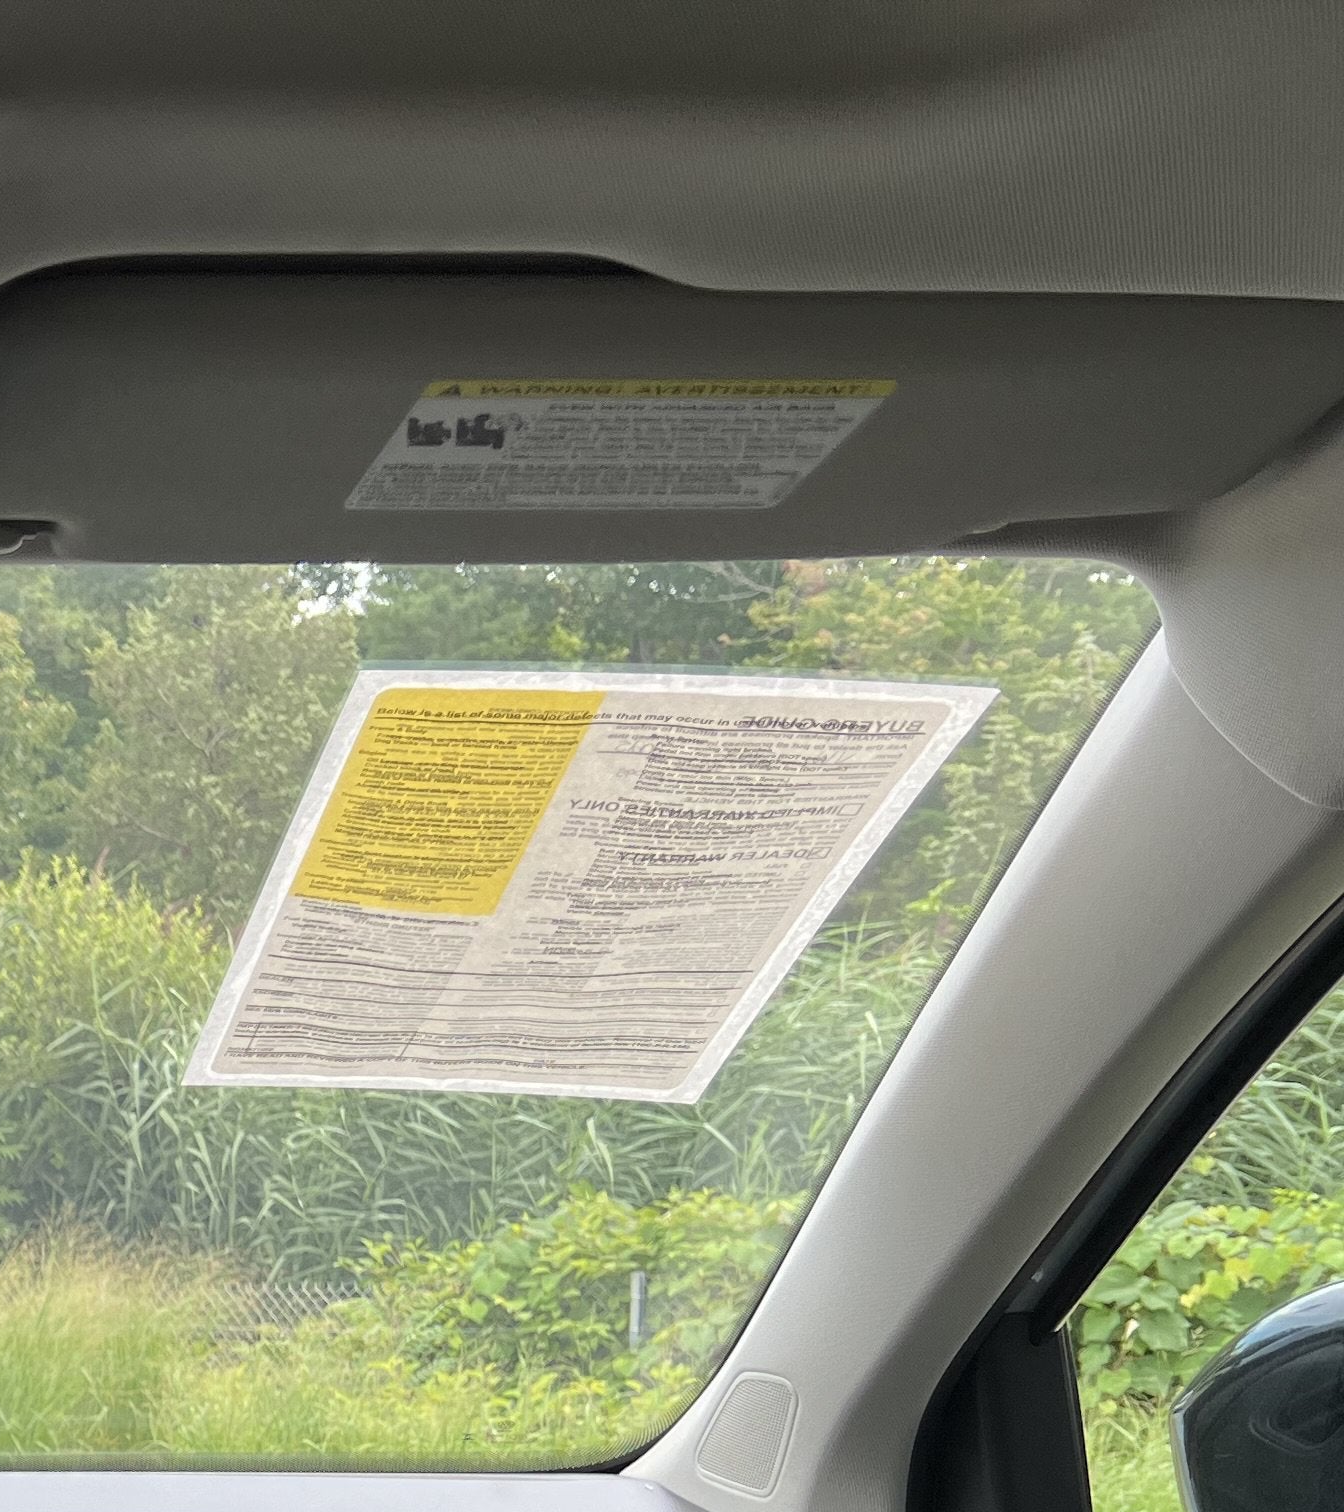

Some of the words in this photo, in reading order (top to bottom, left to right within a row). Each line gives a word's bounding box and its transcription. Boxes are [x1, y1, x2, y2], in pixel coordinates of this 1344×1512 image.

[616, 712, 642, 720] that
[644, 714, 673, 723] may
[676, 716, 715, 724] occur
[717, 718, 730, 726] in
